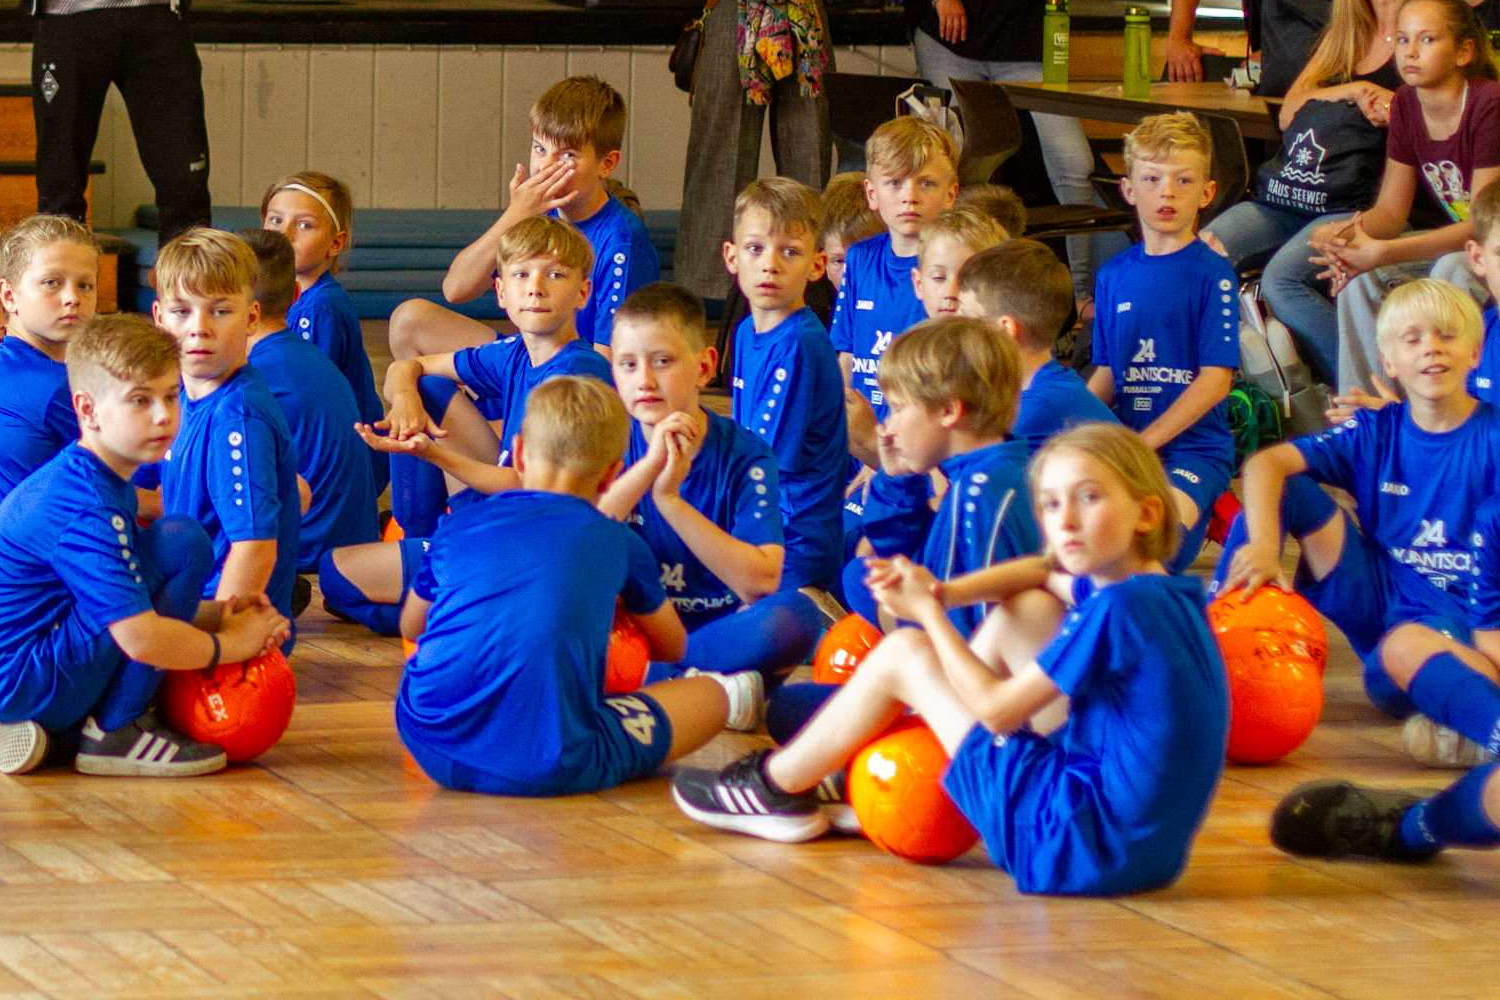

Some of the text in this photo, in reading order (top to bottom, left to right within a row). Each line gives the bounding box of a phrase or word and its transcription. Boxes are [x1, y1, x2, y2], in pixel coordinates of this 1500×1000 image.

[1268, 178, 1328, 205] HAUS SEEWEG
[1132, 338, 1156, 362] 24
[1381, 482, 1410, 496] JAKO
[844, 502, 865, 516] JAK
[1411, 518, 1447, 548] 24
